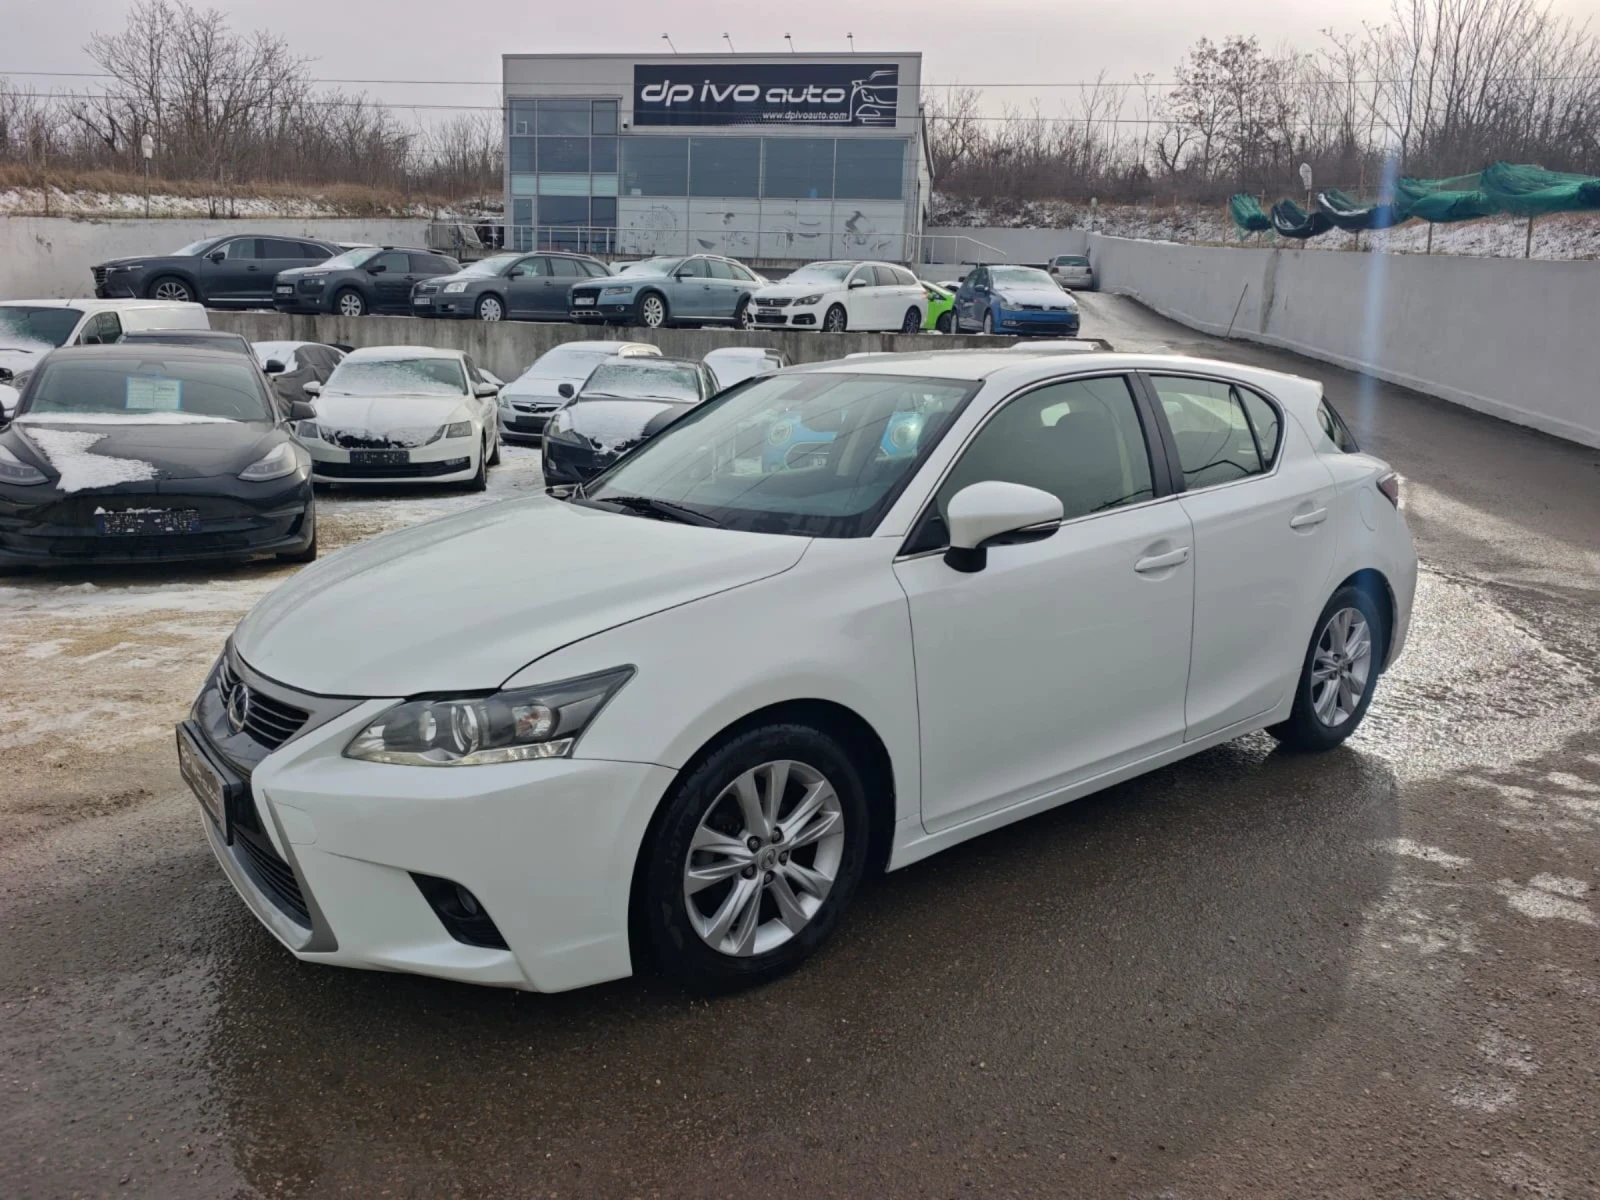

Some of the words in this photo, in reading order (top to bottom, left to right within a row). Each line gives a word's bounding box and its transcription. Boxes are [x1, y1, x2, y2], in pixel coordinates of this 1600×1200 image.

[641, 79, 694, 107] dp
[700, 79, 761, 102] ivo
[765, 84, 846, 103] auto
[762, 110, 847, 121] www.dpivoauto.com
